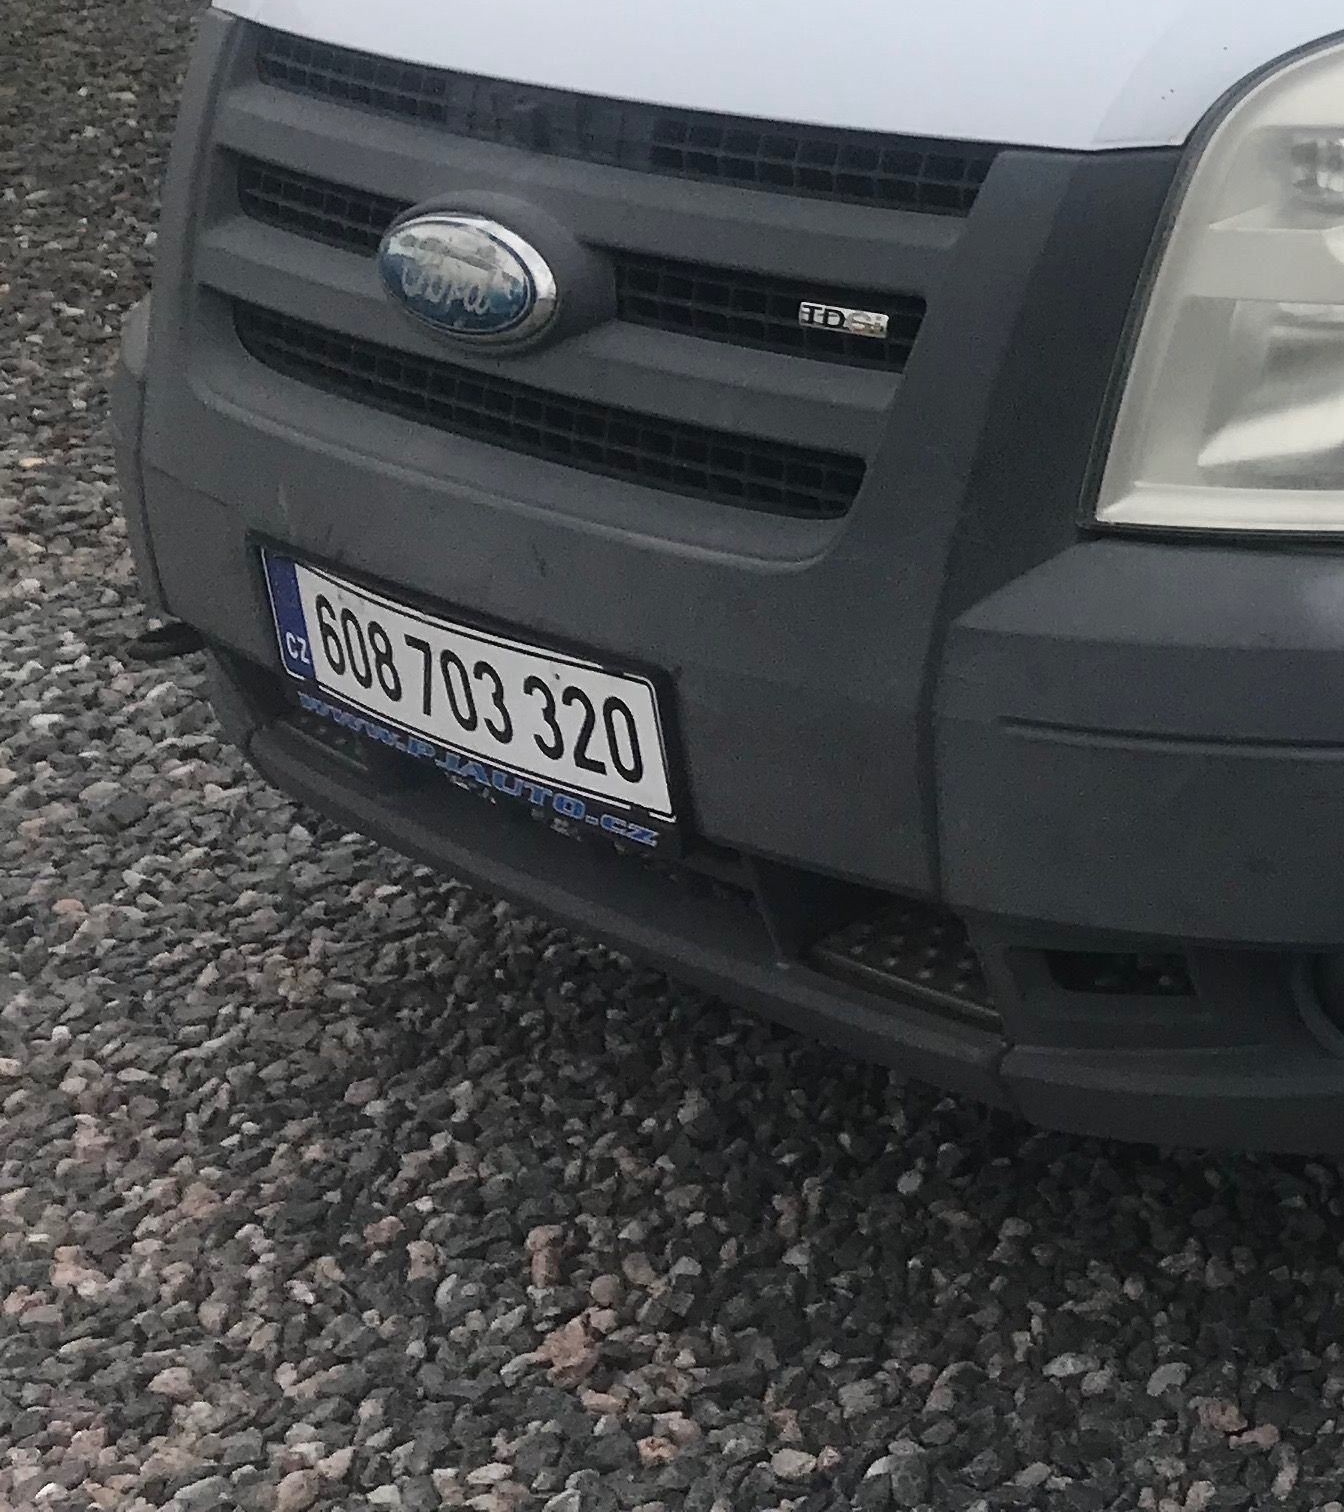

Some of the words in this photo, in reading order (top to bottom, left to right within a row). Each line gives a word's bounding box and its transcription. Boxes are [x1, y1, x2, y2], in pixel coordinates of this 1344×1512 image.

[286, 631, 310, 664] CZ
[315, 594, 402, 702] 608
[404, 634, 513, 744] 703
[523, 675, 643, 783] 320
